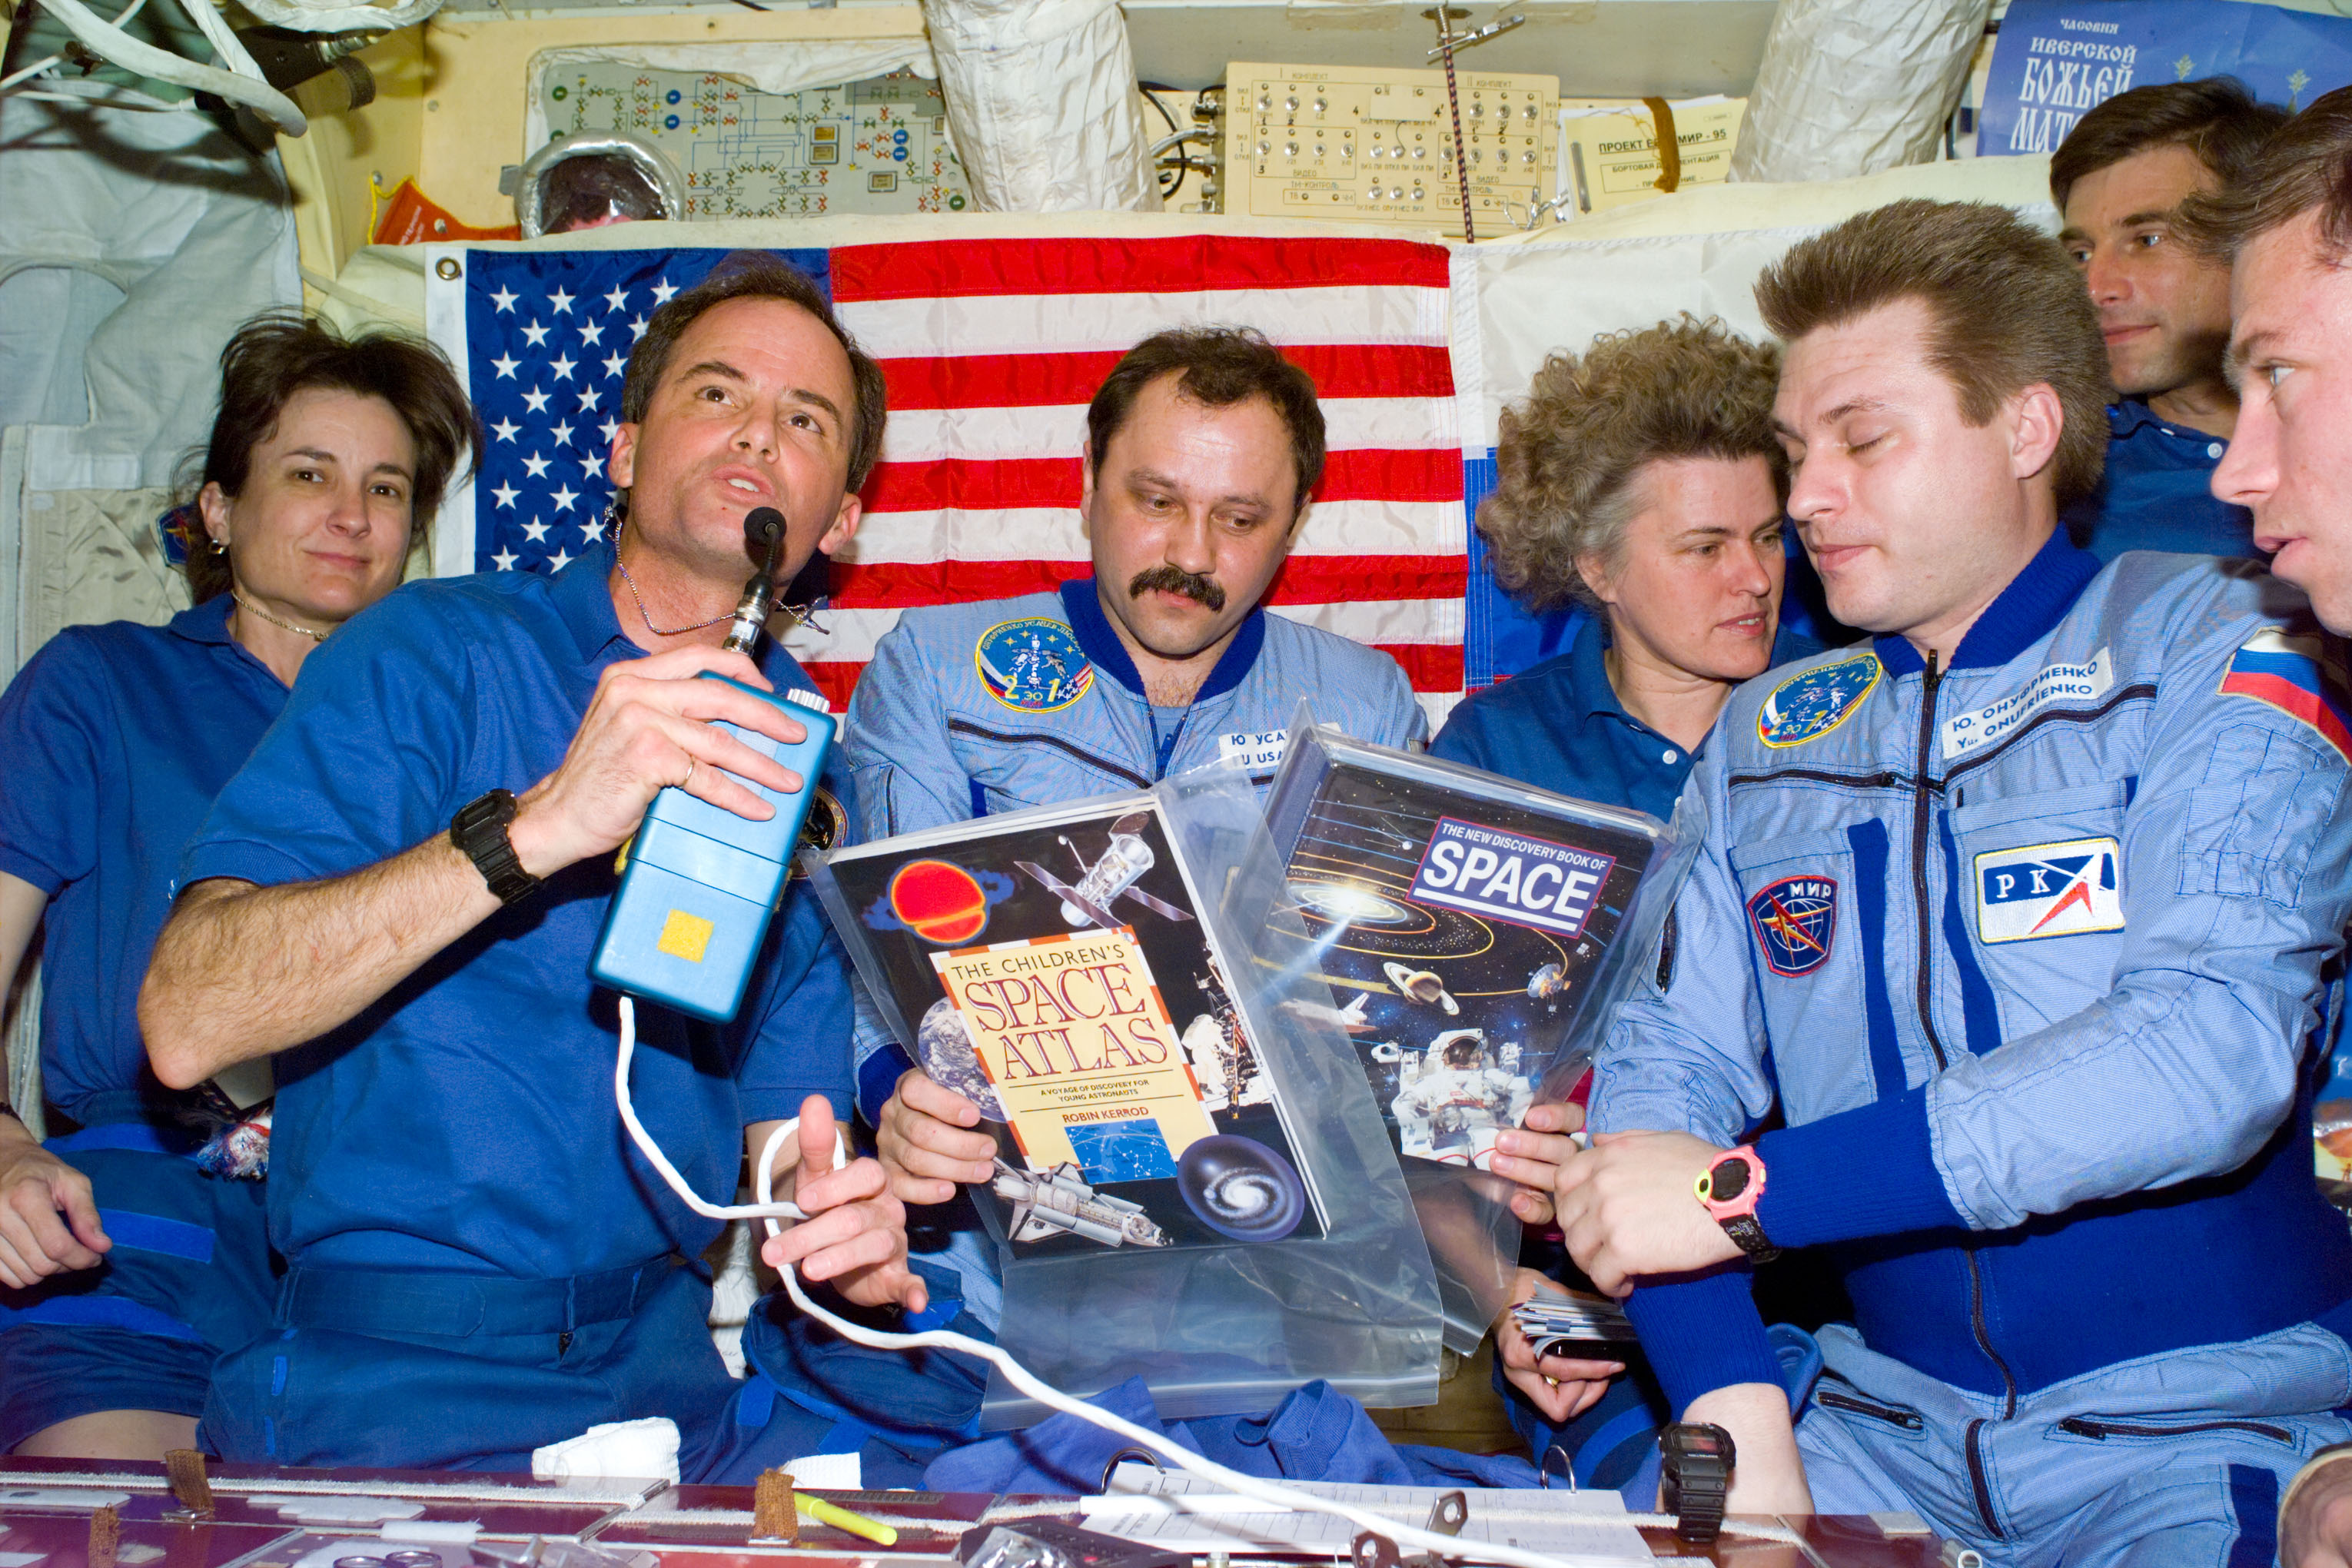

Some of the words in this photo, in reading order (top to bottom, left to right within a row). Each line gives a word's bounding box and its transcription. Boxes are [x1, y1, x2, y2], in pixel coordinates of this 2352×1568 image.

[2030, 37, 2138, 64] ИВЕРСКОЙ
[1598, 140, 1643, 153] ПРОЕКТ
[1713, 128, 1726, 139] 95
[1293, 169, 1317, 178] ВИДЕО
[1476, 175, 1500, 184] ВИДЕО
[1612, 162, 1655, 173] БОРТОВАЯ
[1002, 675, 1019, 699] 2
[1047, 678, 1061, 703] 1
[1952, 717, 1977, 733] Ю.
[1982, 661, 2098, 719] ОНУФРИЕНКО
[1984, 683, 2092, 737] ONUFRIENKO
[1255, 730, 1288, 746] УСА
[1443, 822, 1465, 839] THE
[1464, 826, 1493, 845] NEW
[1492, 835, 1558, 860] DISCOVERY
[1556, 850, 1589, 868] BOOK
[1590, 858, 1609, 871] OF
[1423, 840, 1600, 919] SPACE
[1789, 881, 1832, 899] МИР
[951, 962, 994, 980] THE
[1001, 943, 1125, 973] CHILDREN'S
[965, 963, 1146, 1032] SPACE
[998, 1018, 1168, 1080] ATLAS
[1046, 1086, 1078, 1095] VOYAGE
[1090, 1081, 1132, 1091] DISCOVERY
[1058, 1094, 1087, 1102] YOUNG
[1088, 1088, 1138, 1100] ASTRONAUTS
[1062, 1111, 1101, 1123] ROBIN
[1101, 1106, 1149, 1119] KERROD
